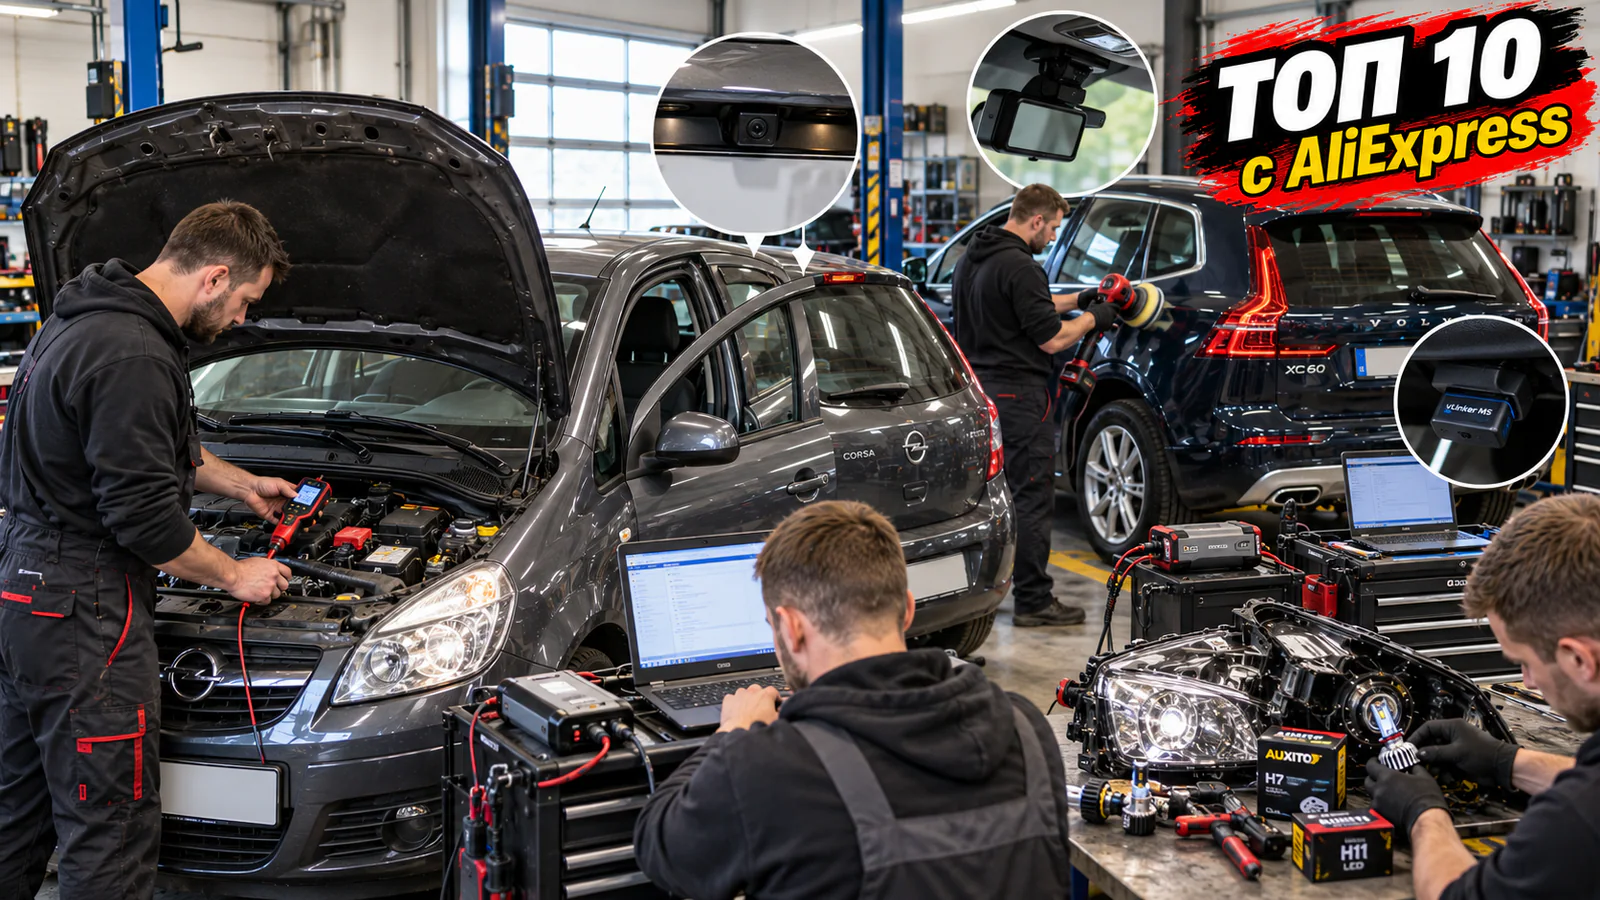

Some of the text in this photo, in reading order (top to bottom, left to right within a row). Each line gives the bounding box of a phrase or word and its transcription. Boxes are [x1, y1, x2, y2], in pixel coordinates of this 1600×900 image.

[1285, 364, 1326, 375] XC60
[1478, 407, 1493, 416] MS
[843, 449, 876, 461] CORSA
[1265, 748, 1312, 764] AUXITO
[1265, 772, 1284, 785] H7
[1340, 843, 1368, 861] H11
